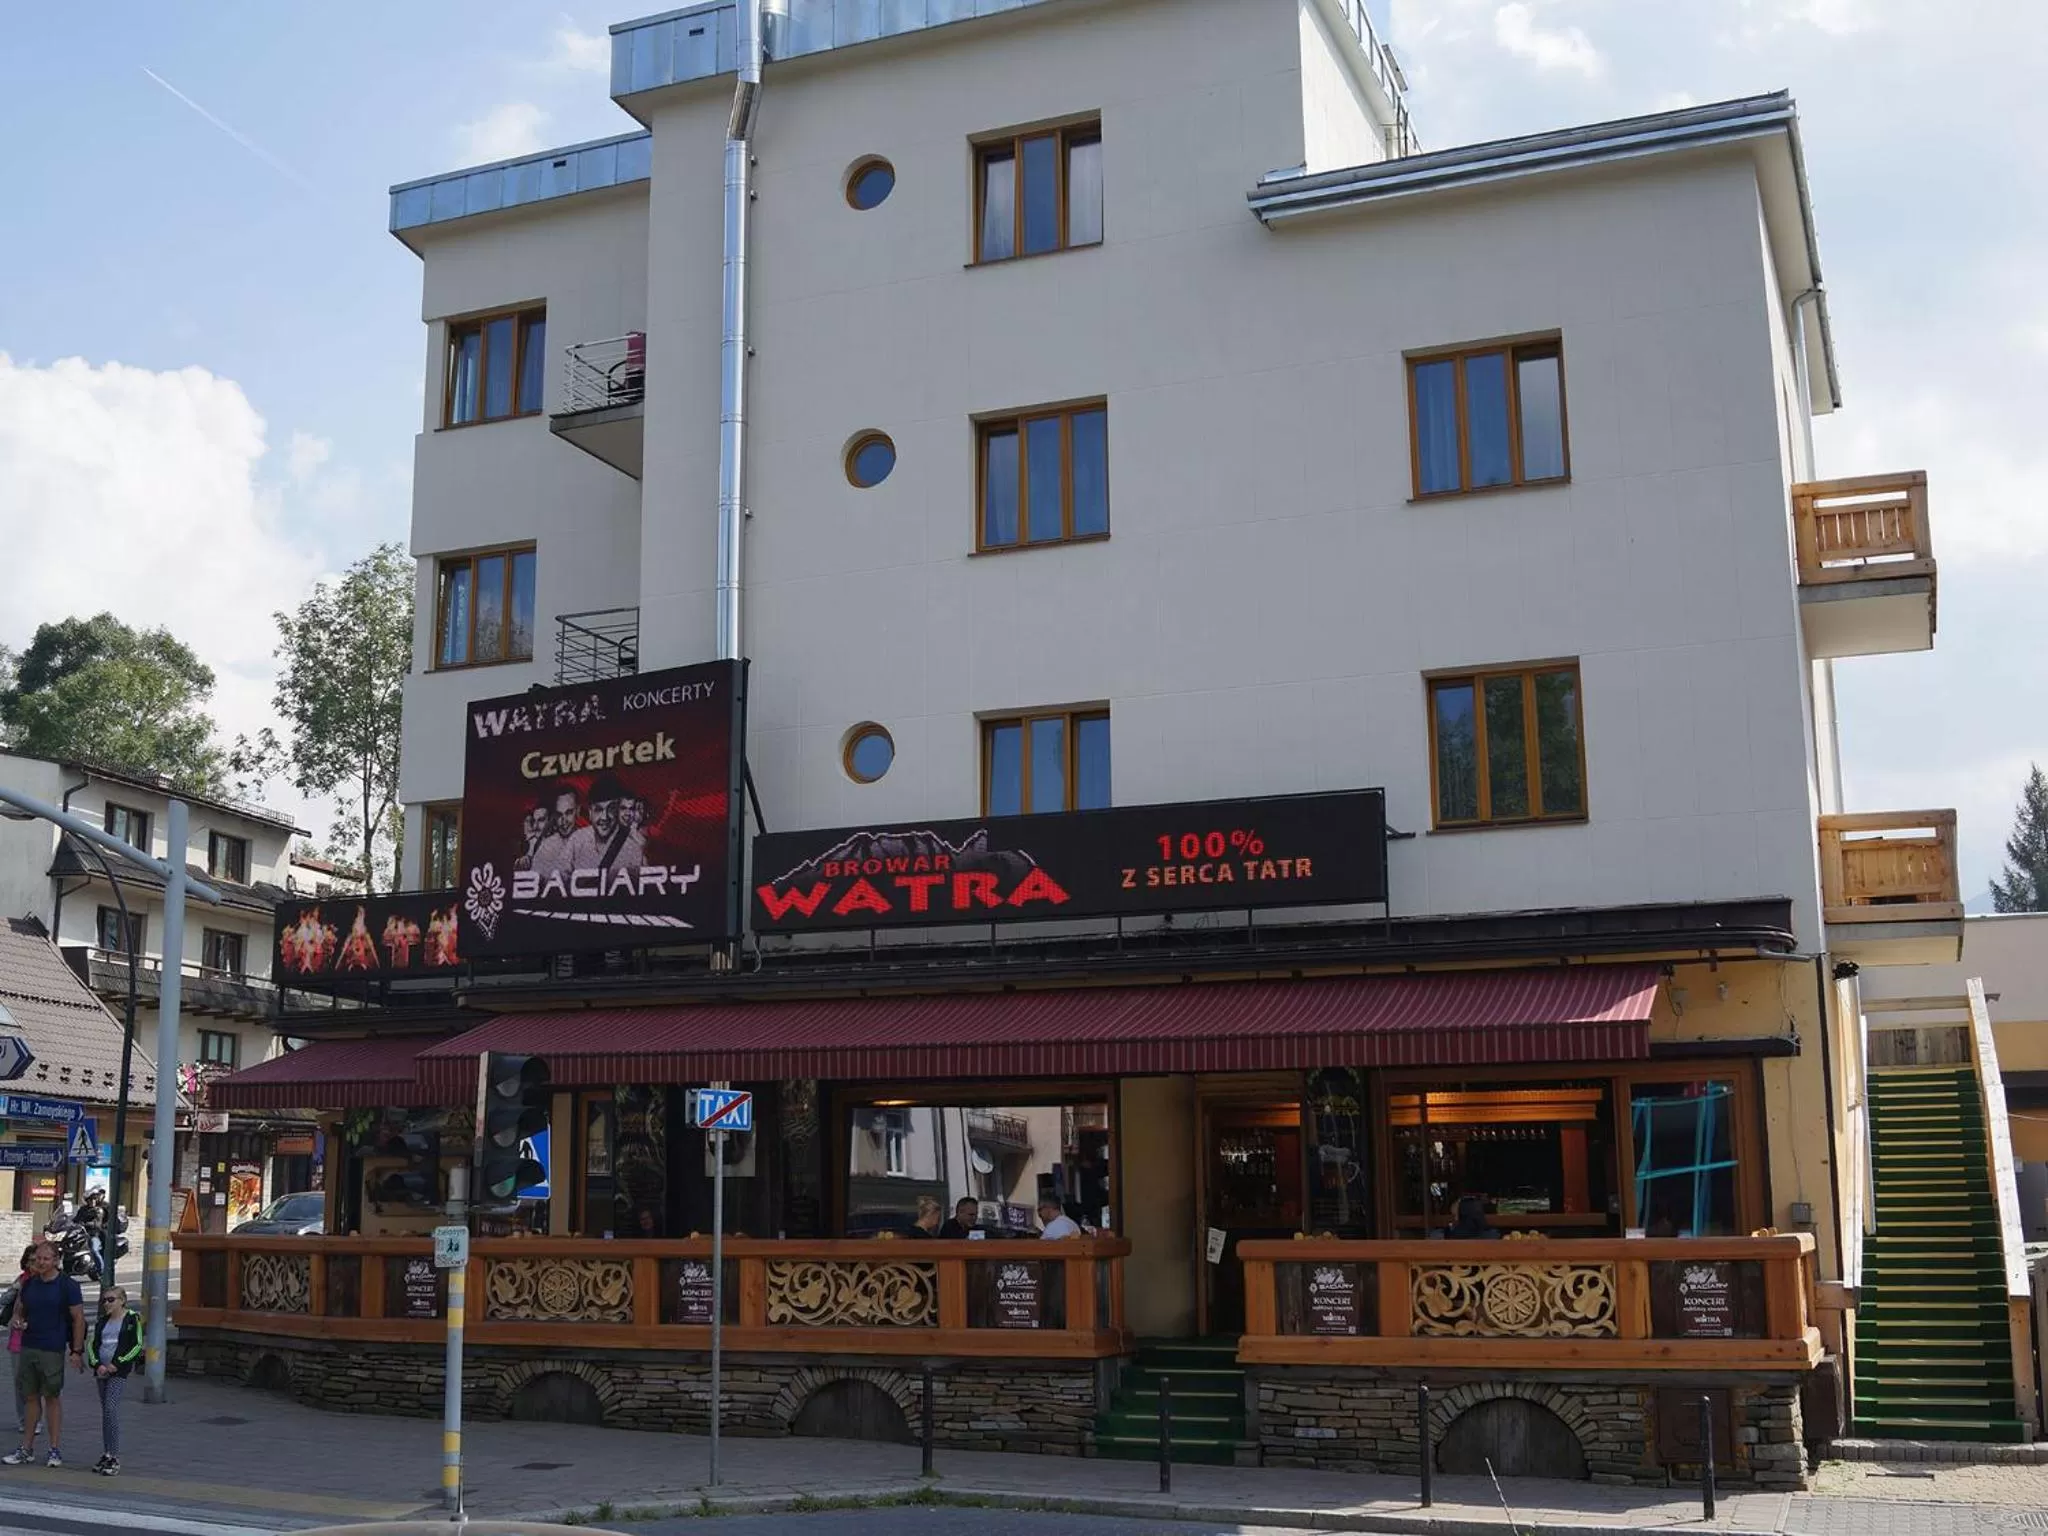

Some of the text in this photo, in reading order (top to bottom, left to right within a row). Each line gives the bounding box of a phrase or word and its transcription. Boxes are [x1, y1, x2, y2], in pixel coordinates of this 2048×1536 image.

[623, 681, 715, 711] KONCERTY
[520, 731, 676, 780] Czwartek
[1156, 829, 1264, 861] 100%
[512, 864, 701, 900] BACIARY
[823, 855, 951, 878] BROWAR
[1121, 858, 1313, 889] Z SERCA TATR
[756, 866, 1072, 921] WATRA
[701, 1094, 748, 1126] TAXI
[1000, 1292, 1034, 1300] KONCERT
[1313, 1296, 1351, 1305] KONCERT
[1684, 1297, 1725, 1306] KONCERT
